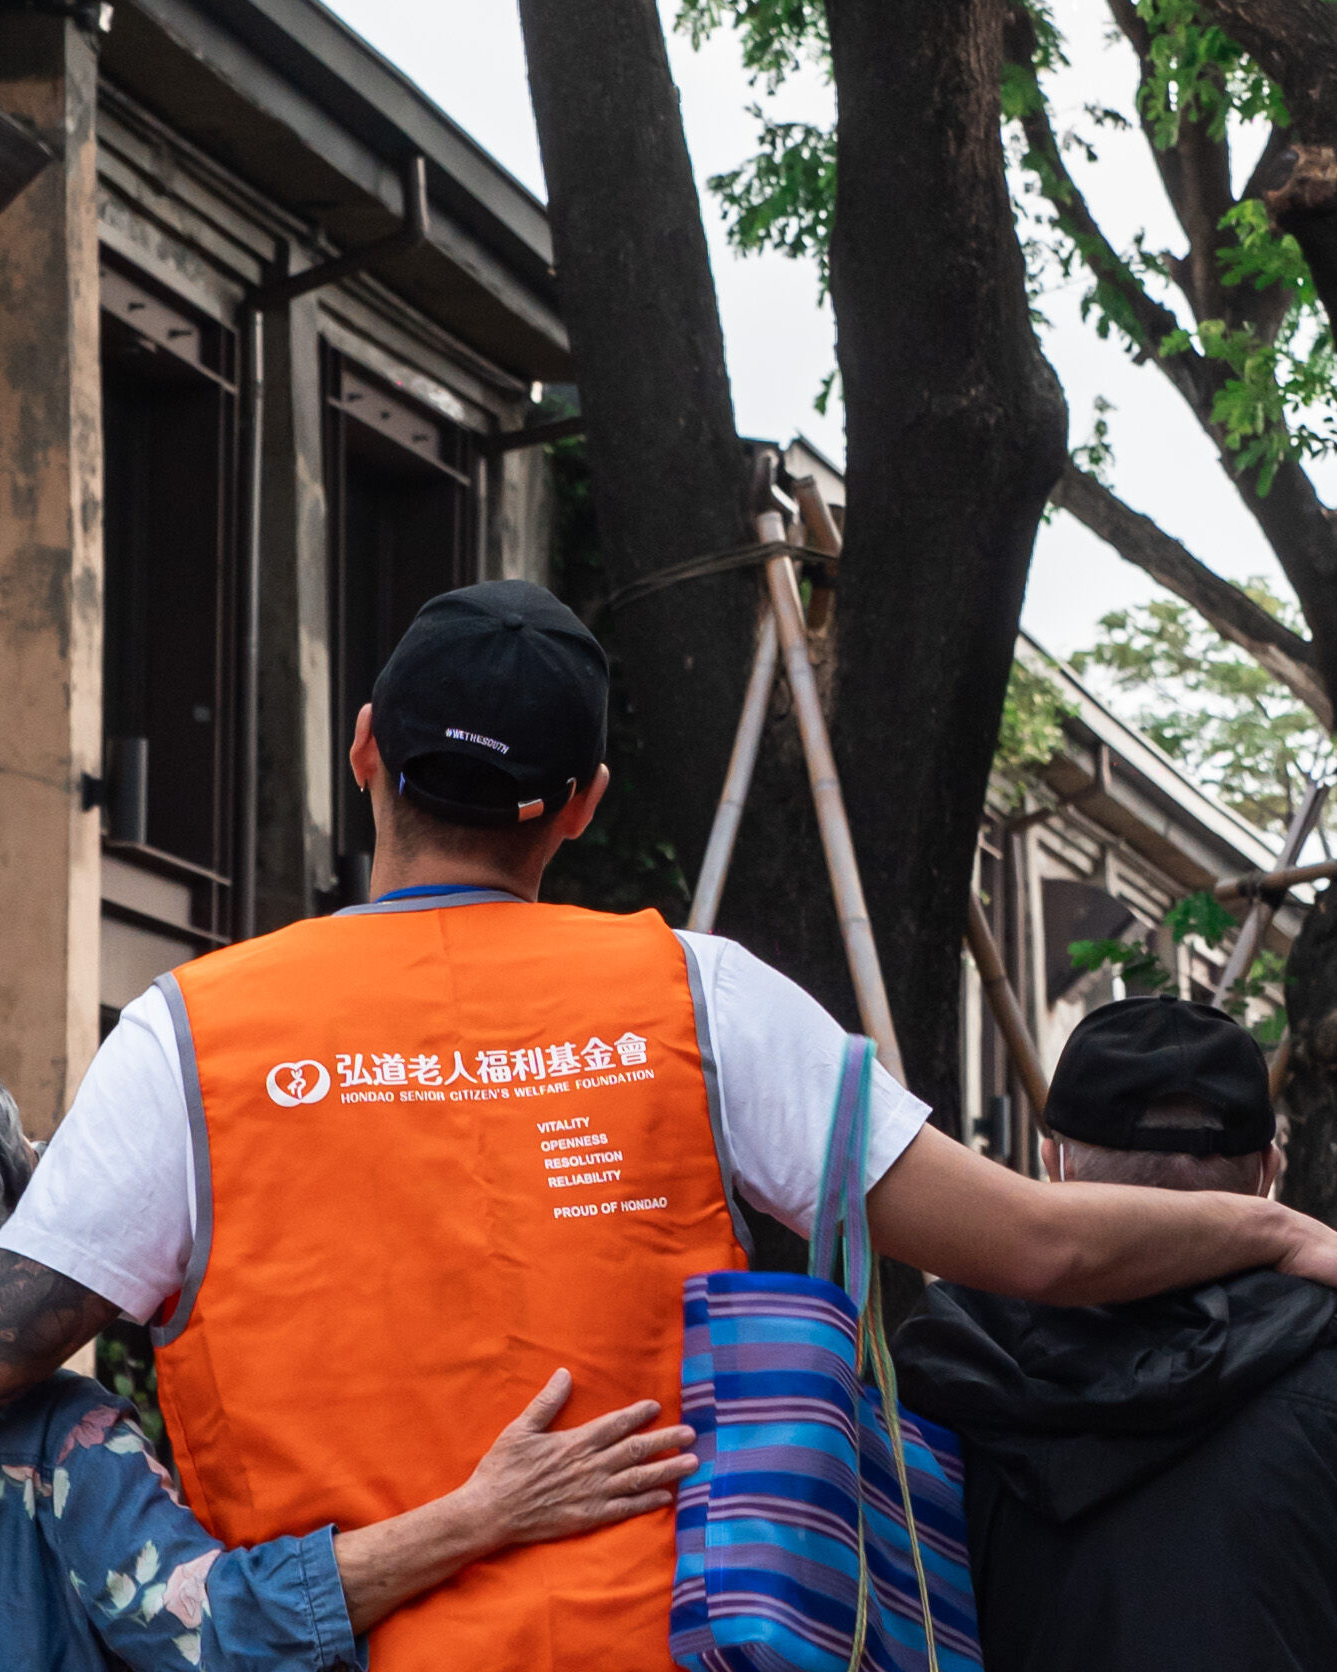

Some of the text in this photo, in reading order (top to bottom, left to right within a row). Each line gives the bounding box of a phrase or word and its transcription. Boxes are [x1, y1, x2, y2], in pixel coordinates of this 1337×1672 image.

[445, 728, 509, 755] #WETHESOUTH
[335, 1031, 647, 1088] 弘道老人福利基金會
[340, 1069, 655, 1104] HONDAO SENIOR CITIZEN'S WELFARE FOUNDATION
[537, 1116, 590, 1134] VITALITY
[541, 1133, 608, 1152] OPENNESS
[544, 1150, 623, 1170] RESOLUTION
[548, 1169, 621, 1188] RELIABILITY
[553, 1197, 668, 1219] PROUD OF HONDAO
